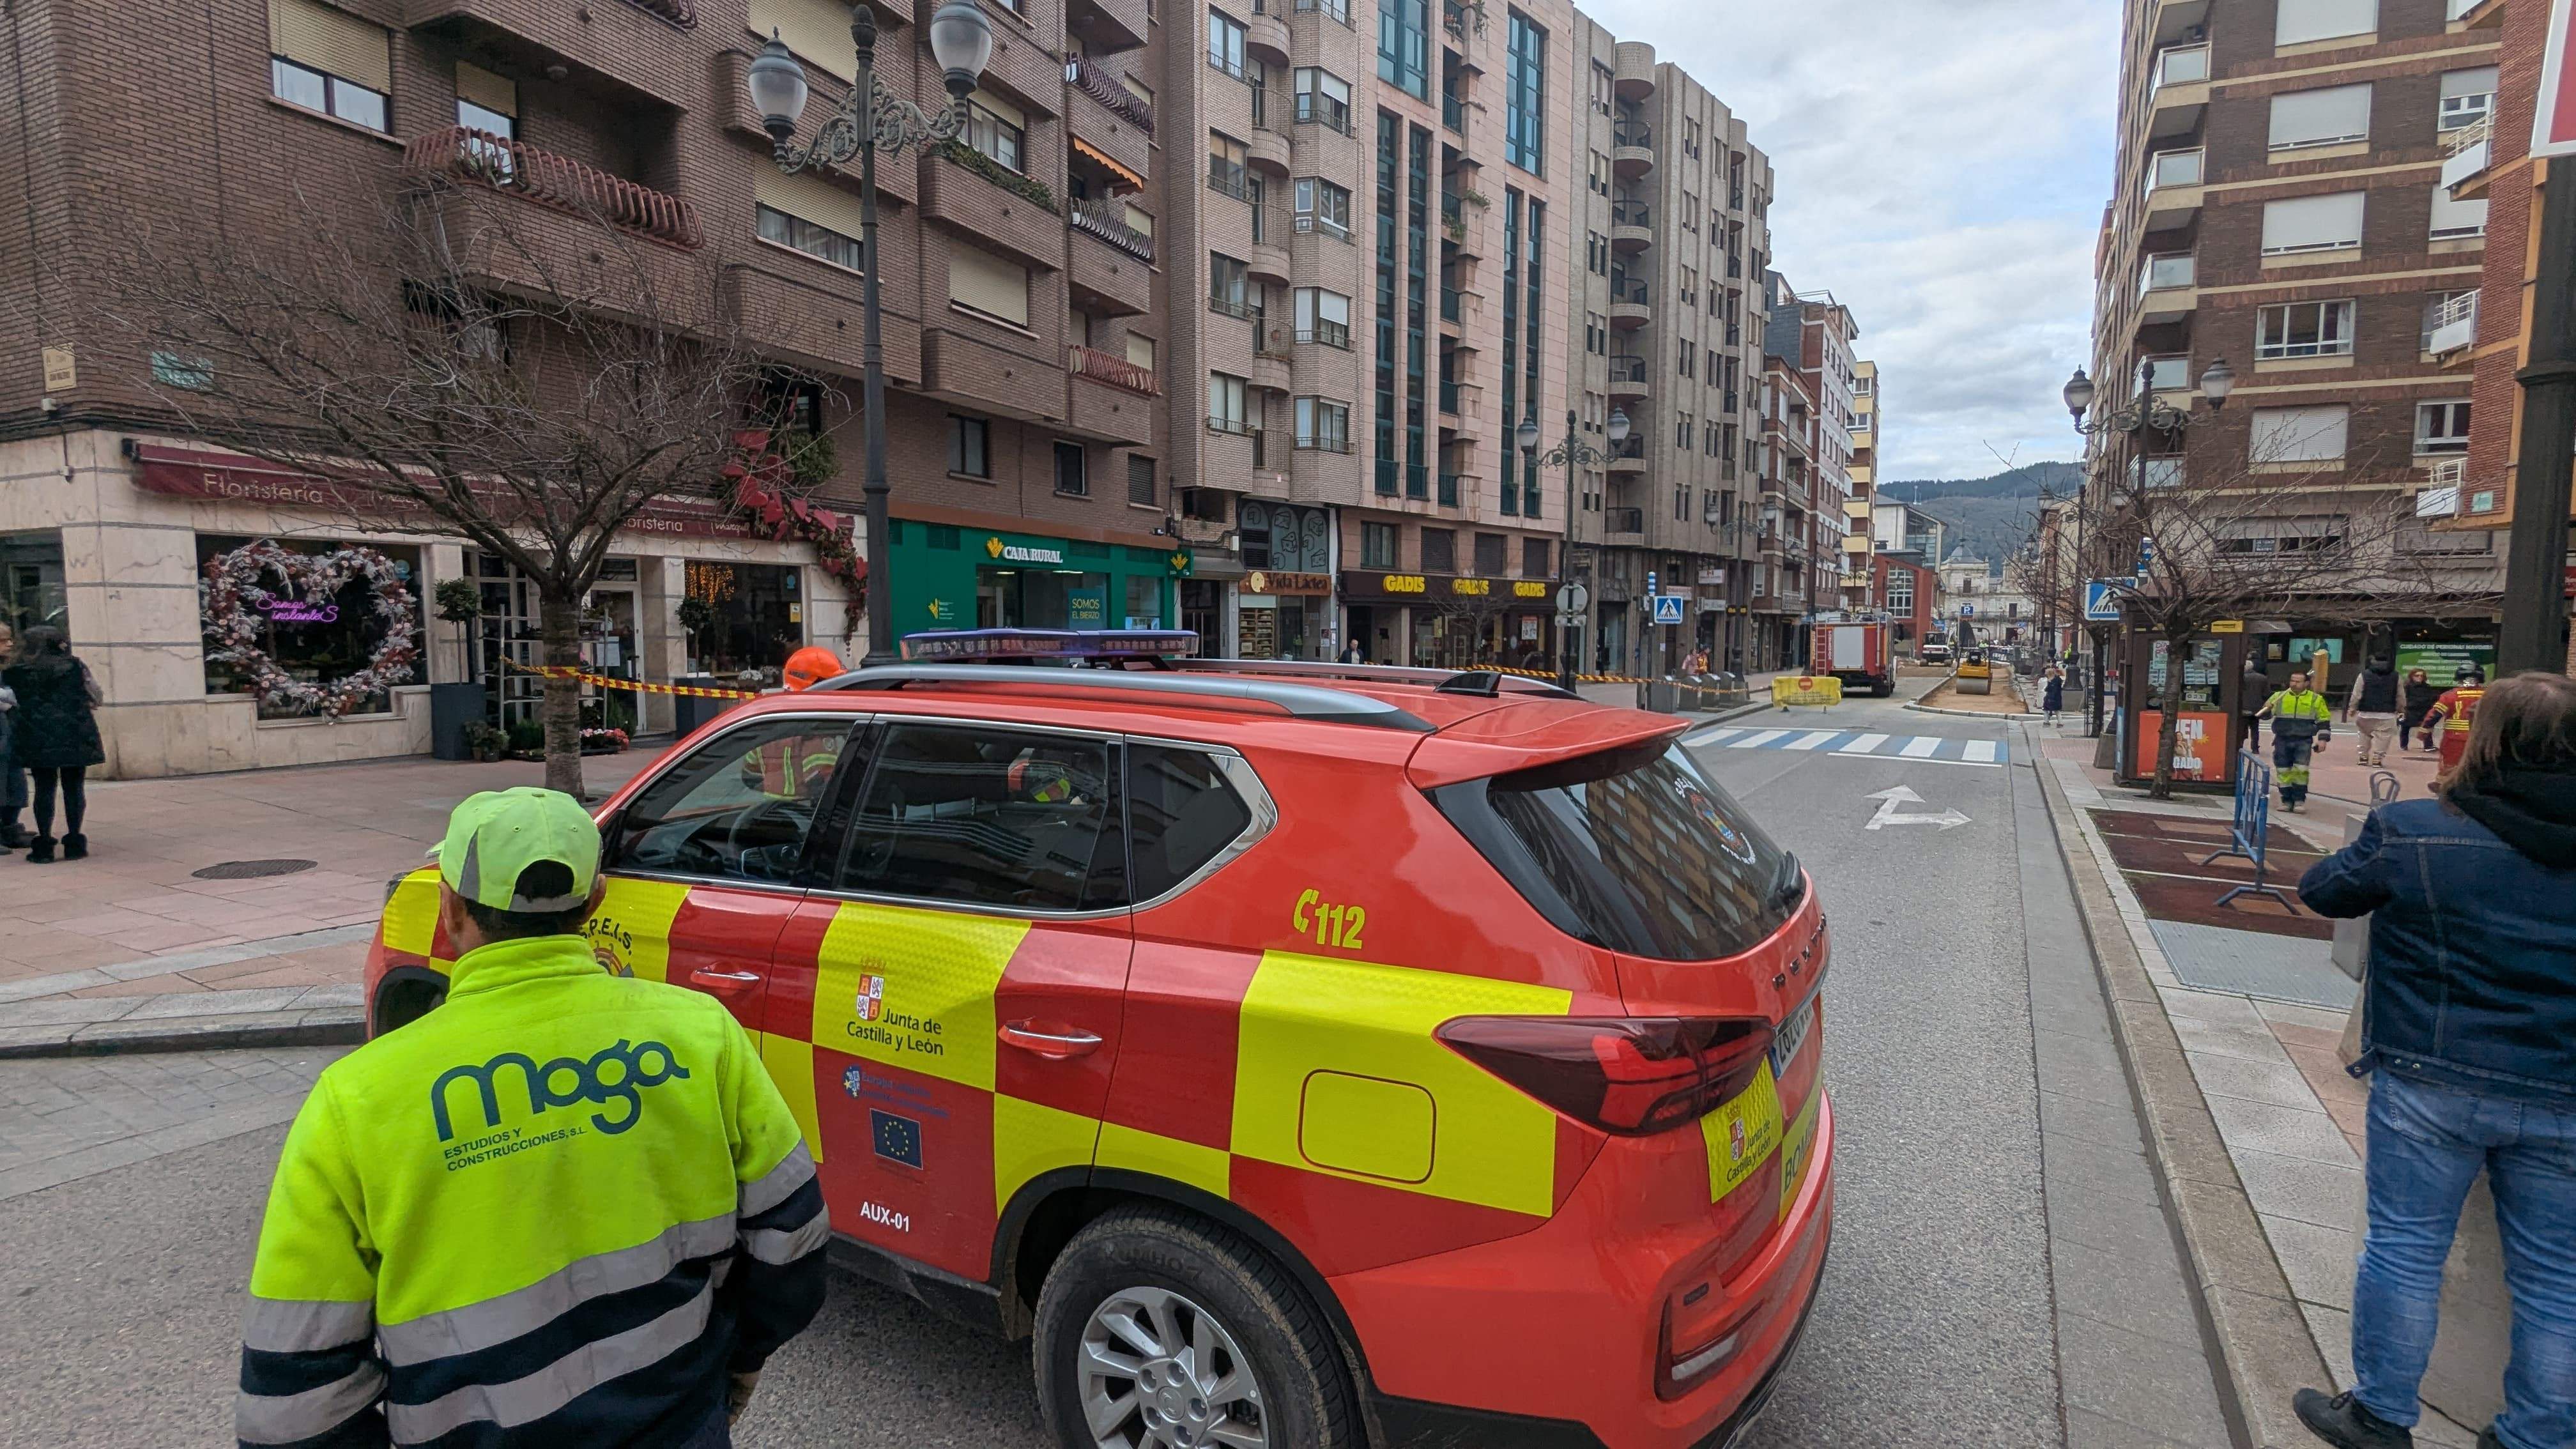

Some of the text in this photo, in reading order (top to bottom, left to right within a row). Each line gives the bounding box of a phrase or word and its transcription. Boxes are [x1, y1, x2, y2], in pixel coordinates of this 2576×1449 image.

[1003, 546, 1063, 563] CAJA RURAL
[1266, 573, 1292, 588] Vida
[1383, 575, 1425, 593] GADIS
[1513, 582, 1546, 597] GADIS
[1072, 598, 1100, 609] SOMOS
[1080, 611, 1100, 619] BIERZO
[1315, 903, 1365, 949] 112
[882, 1008, 942, 1035] Junta de
[847, 1021, 944, 1055] Castilla y León
[444, 1127, 522, 1159] ESTUDIOS Y
[1746, 1119, 1770, 1151] Junta de
[447, 1128, 570, 1172] CONSTRUCCIONES,
[1726, 1155, 1752, 1183] Castilla
[1758, 1135, 1771, 1157] León
[860, 1201, 910, 1232] AUX-01
